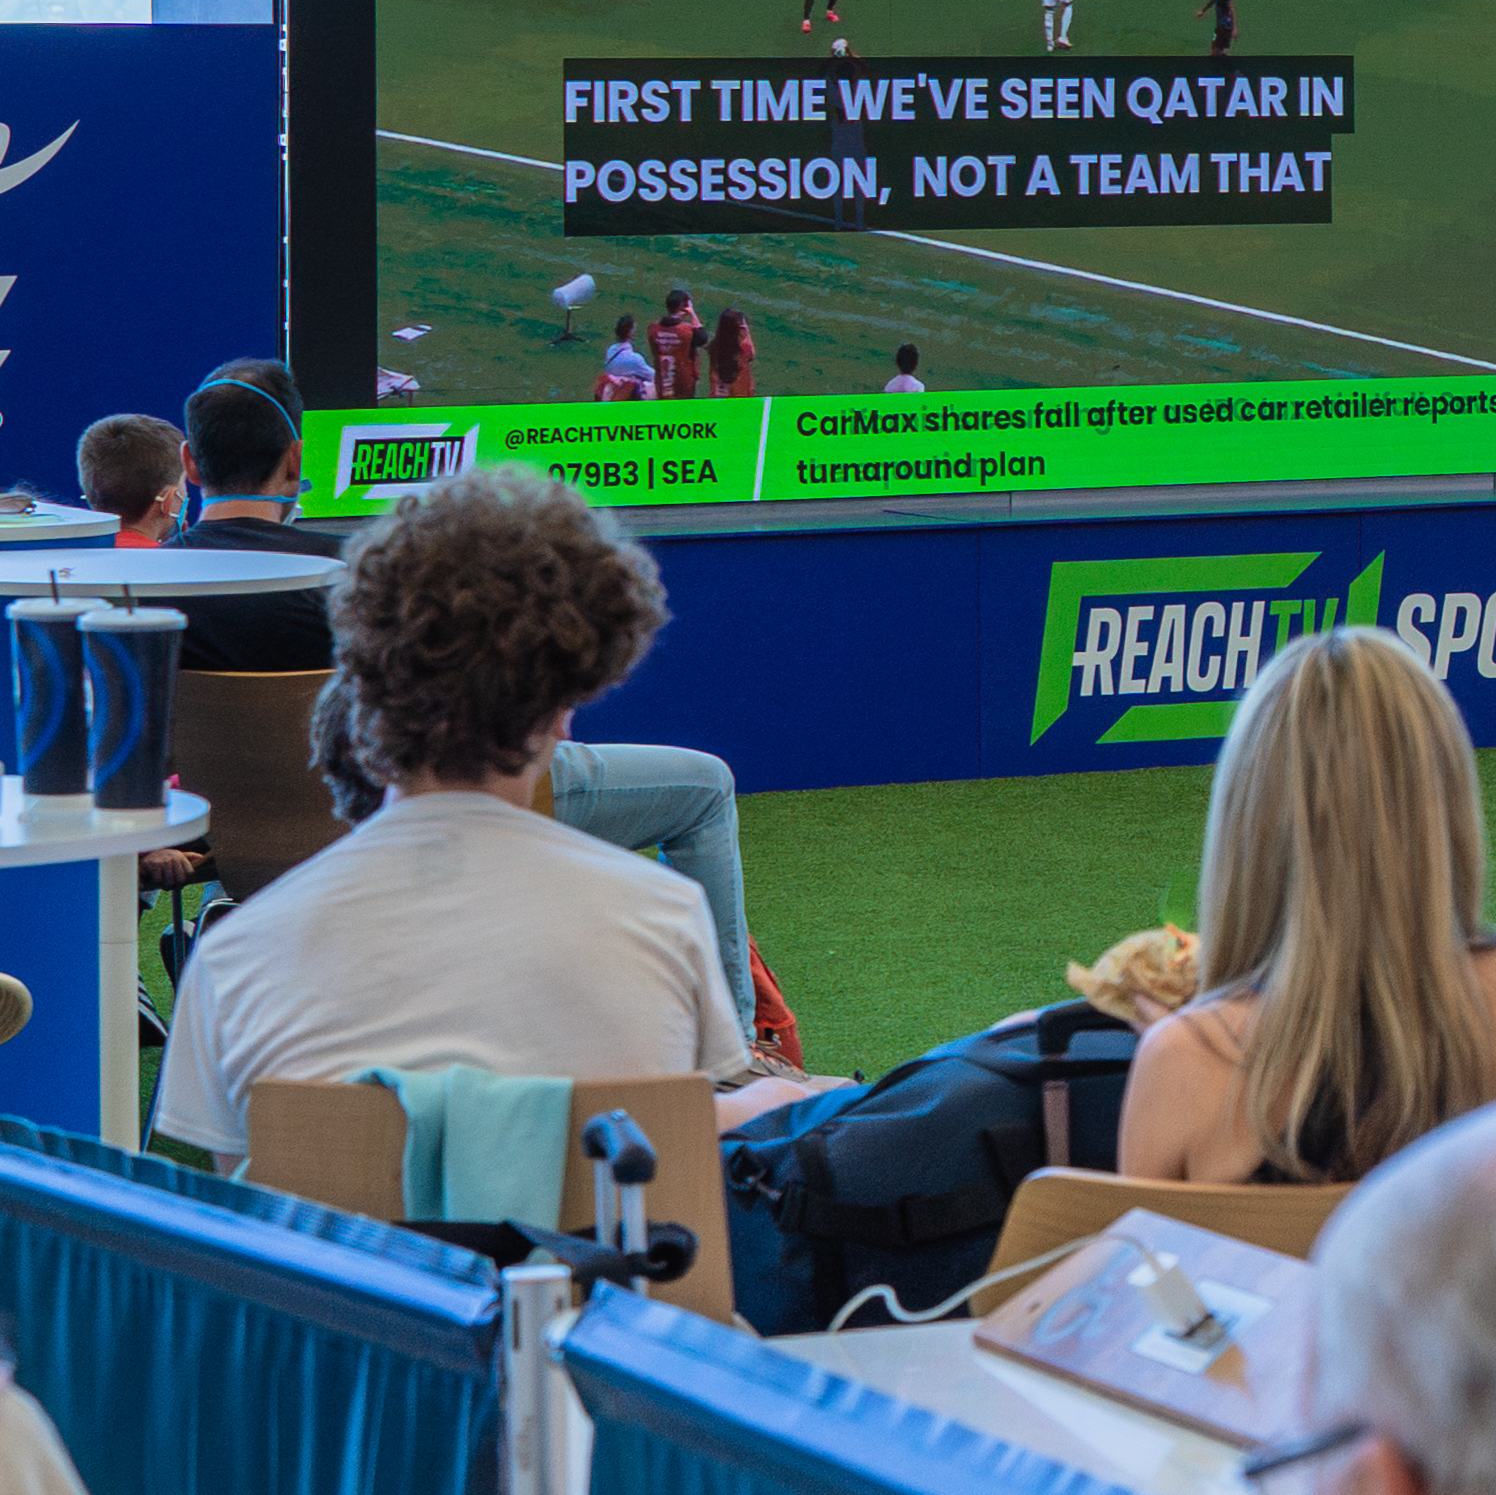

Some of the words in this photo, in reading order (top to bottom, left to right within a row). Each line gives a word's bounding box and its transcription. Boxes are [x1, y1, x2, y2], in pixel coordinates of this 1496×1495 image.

[565, 79, 701, 123] FIRST
[711, 78, 827, 122] TIME
[838, 73, 989, 121] WE'VE
[1000, 77, 1116, 119] SEEN
[1126, 76, 1288, 125] QATAR
[1299, 76, 1344, 117] IN
[565, 156, 892, 205] POSSESSION,
[913, 155, 1017, 198] NOT
[1025, 154, 1061, 196] A
[1069, 153, 1200, 196] TEAM
[1210, 151, 1332, 193] THAT
[505, 422, 718, 450] @REACHTVNETWORK
[796, 409, 918, 436] CarMax
[924, 405, 1027, 433] shares
[1032, 401, 1081, 430] fall
[1086, 399, 1158, 428] after
[1163, 397, 1234, 424] used
[1240, 400, 1289, 422] car
[1291, 391, 1397, 420] retailer
[352, 436, 463, 483] REACHTV
[662, 459, 719, 486] SEA
[796, 452, 972, 485] turnaround
[980, 450, 1046, 486] plan
